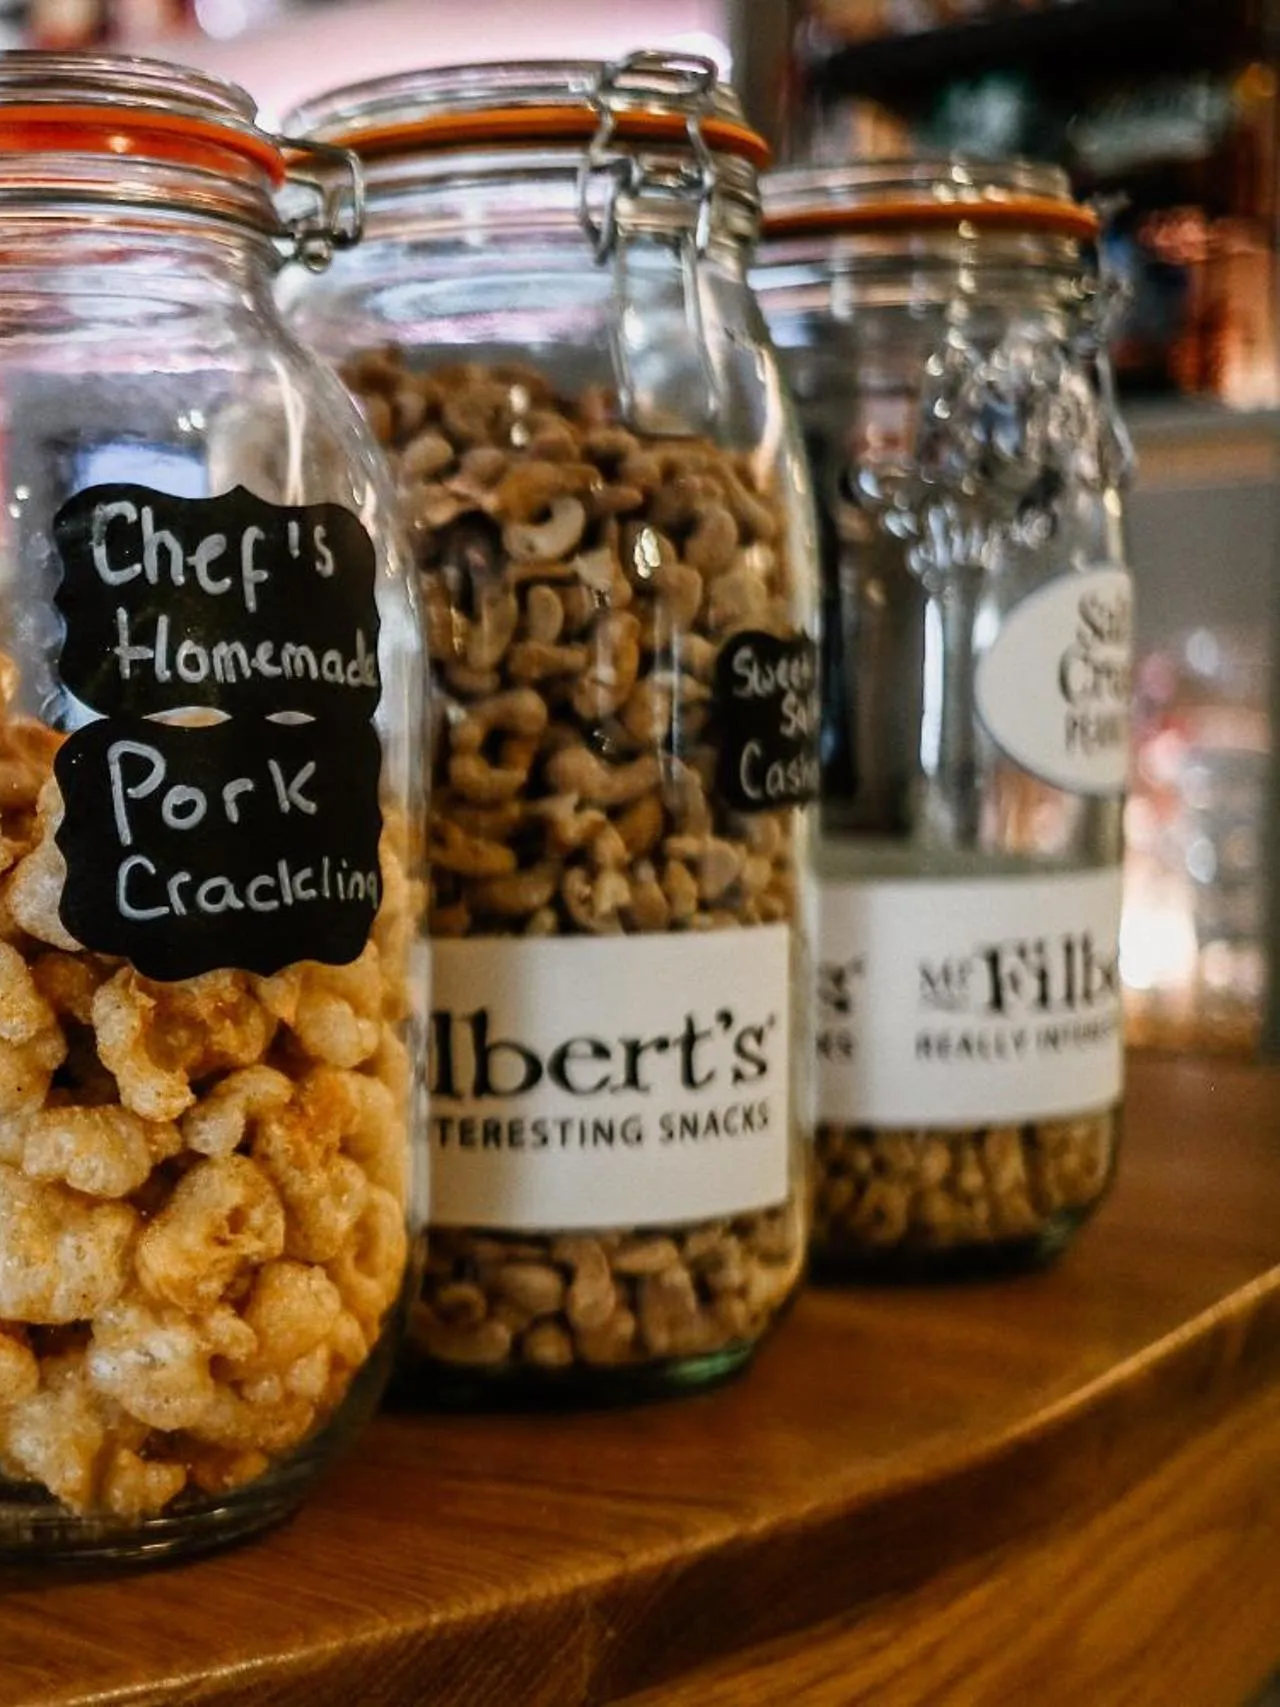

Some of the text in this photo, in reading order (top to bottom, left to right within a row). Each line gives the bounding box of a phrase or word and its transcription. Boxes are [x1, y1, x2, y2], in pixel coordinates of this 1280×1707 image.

[92, 500, 335, 613] Chef's
[107, 740, 317, 846] Pork
[429, 1005, 768, 1099] lbert's
[434, 1101, 769, 1149] TERESTING SNACKS
